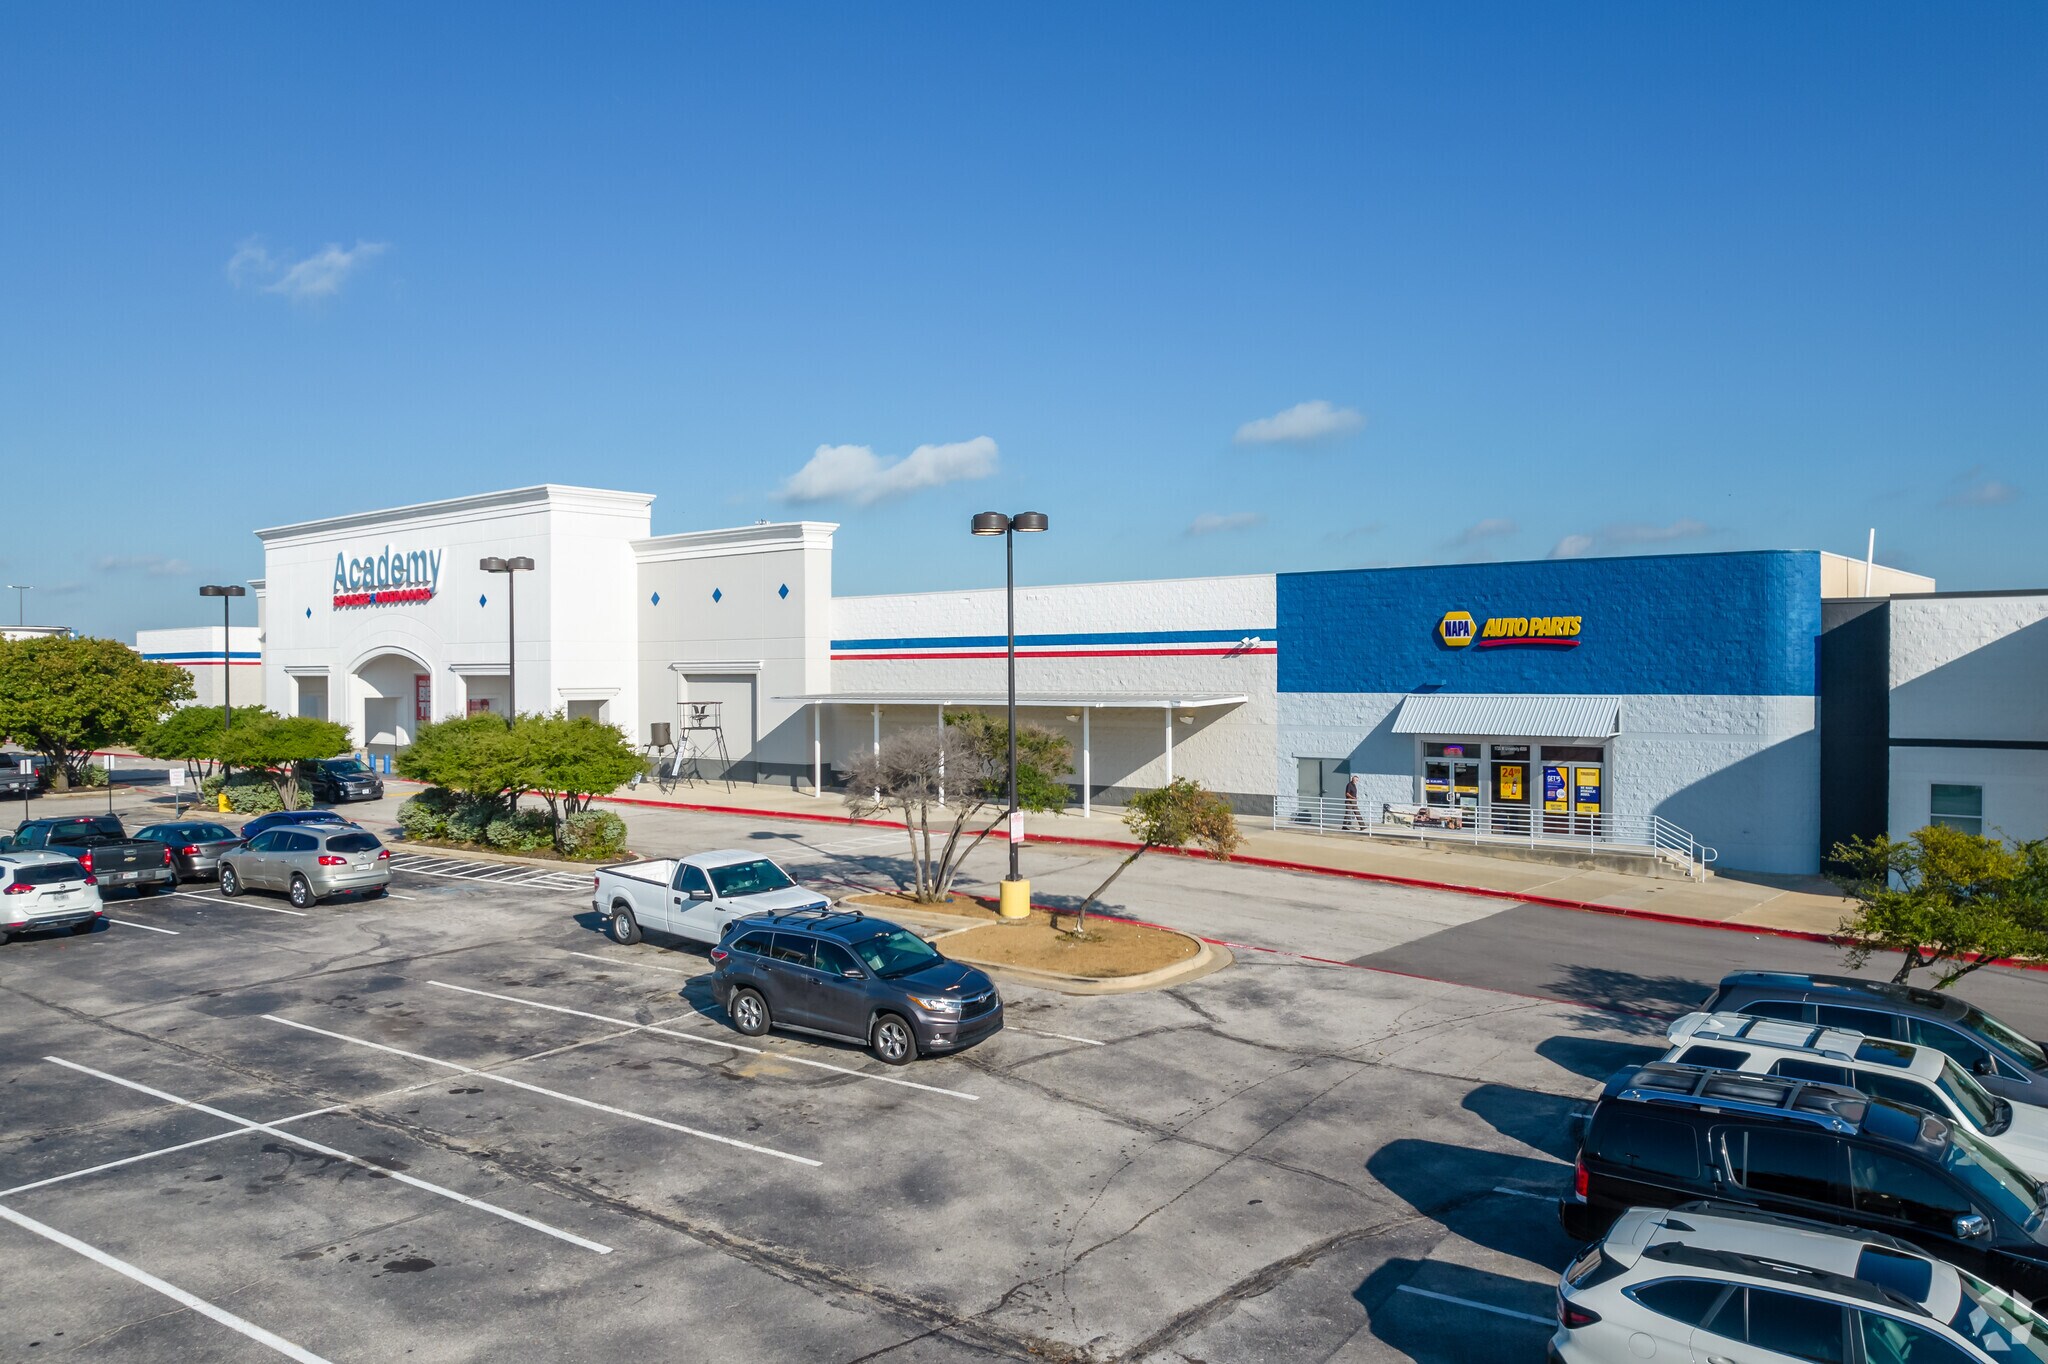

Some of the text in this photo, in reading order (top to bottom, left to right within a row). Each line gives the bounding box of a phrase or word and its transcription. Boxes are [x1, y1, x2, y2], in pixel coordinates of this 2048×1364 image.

[333, 544, 442, 594] Academy
[333, 593, 370, 607] SPORTS
[375, 588, 432, 603] OUTDOORS
[1445, 616, 1582, 637] NAPA AUTO PARTS
